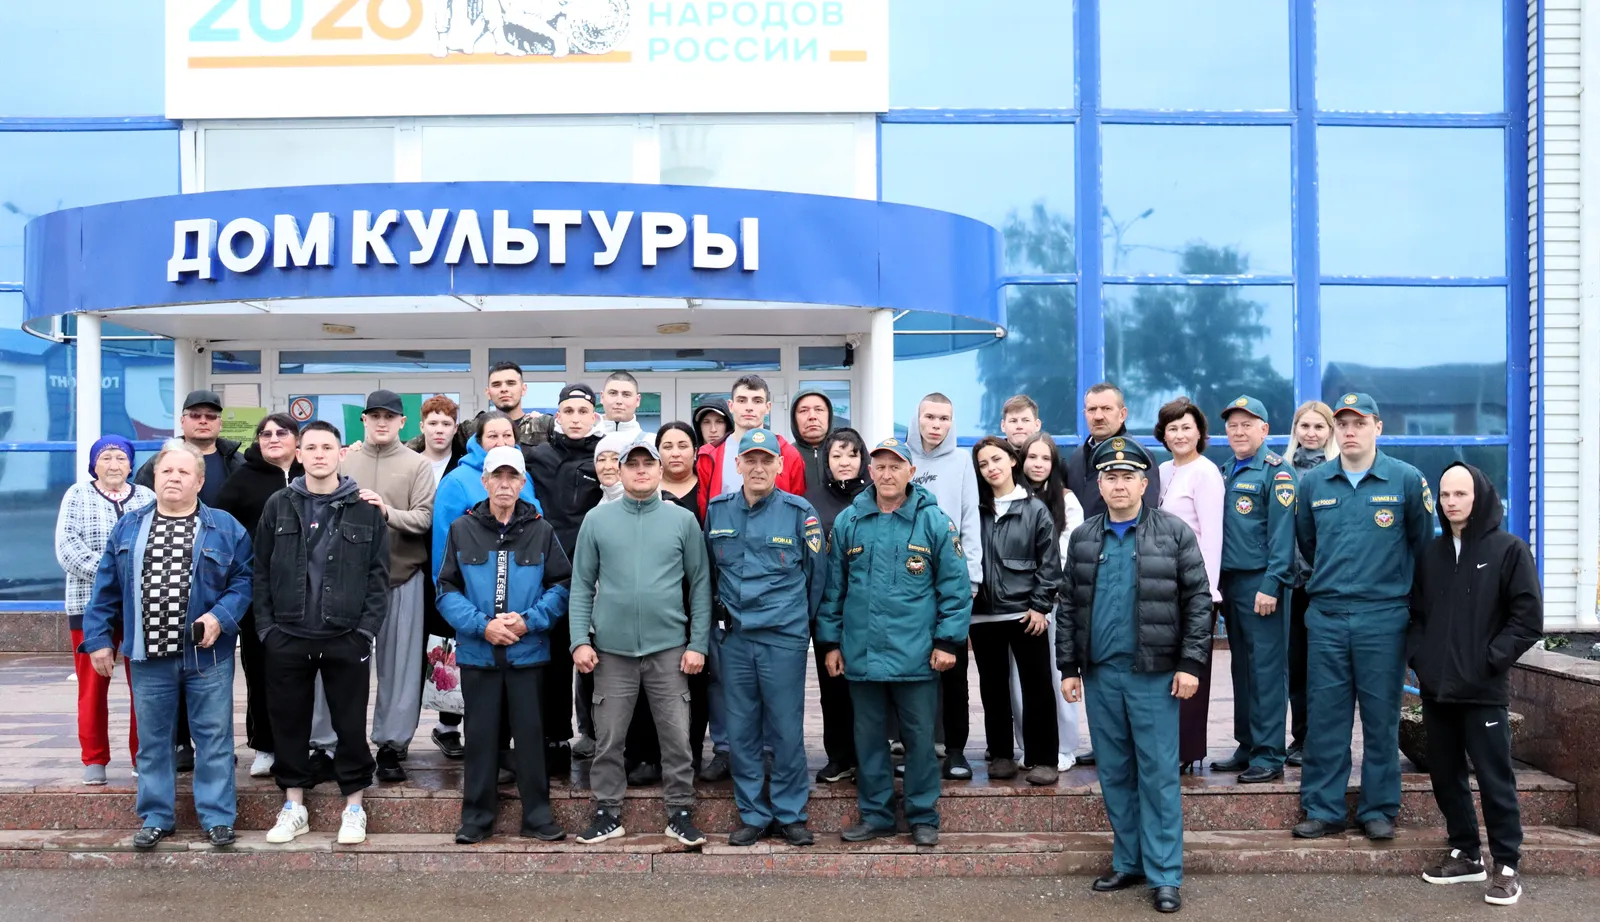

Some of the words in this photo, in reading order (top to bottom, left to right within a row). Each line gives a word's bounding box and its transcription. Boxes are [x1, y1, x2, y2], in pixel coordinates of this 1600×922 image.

[649, 1, 844, 32] НАРОДОВ
[649, 37, 818, 62] РОССИИ
[167, 211, 334, 282] ДОМ
[352, 208, 759, 271] КУЛЬТУРЫ
